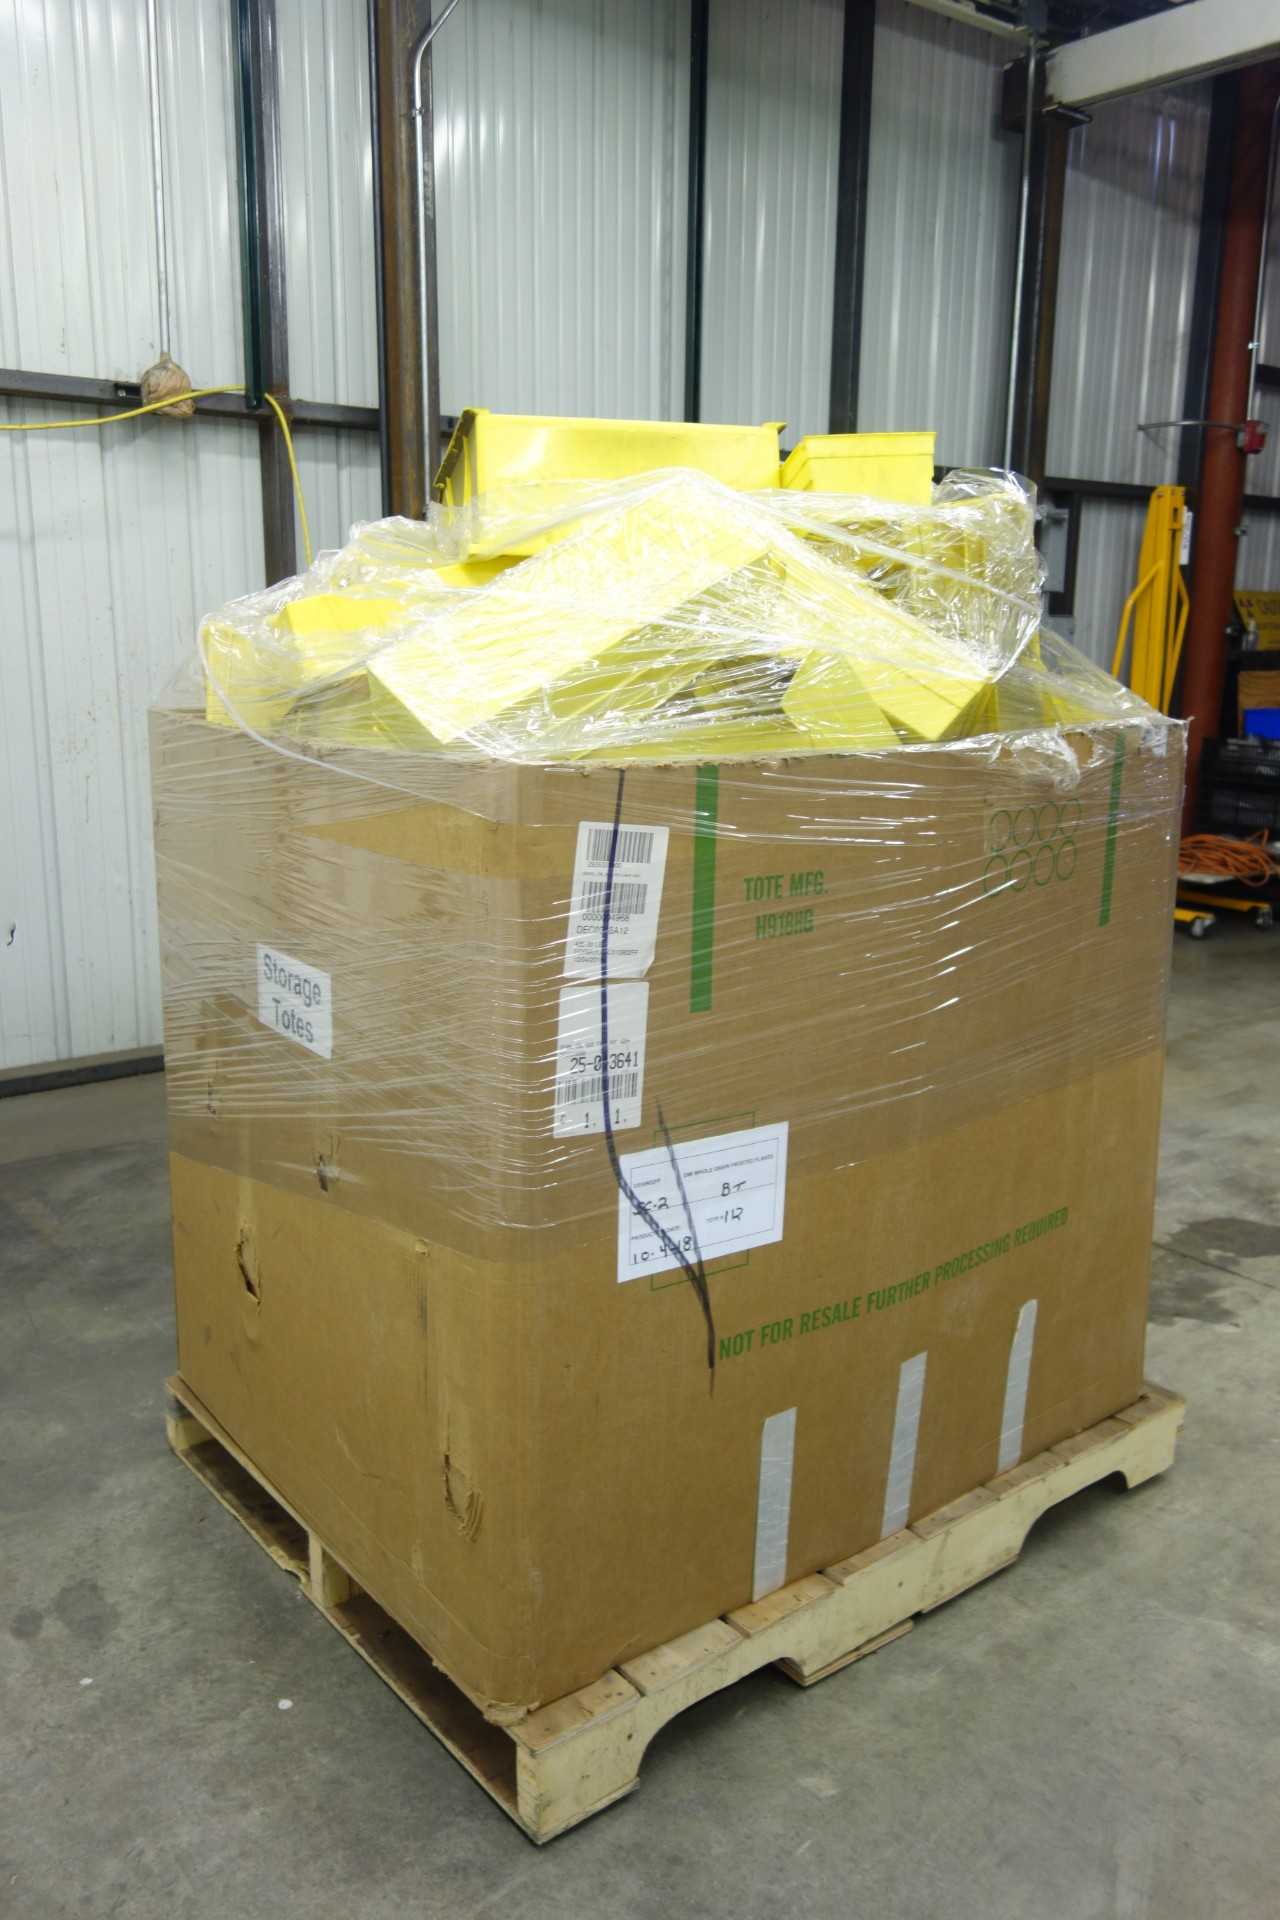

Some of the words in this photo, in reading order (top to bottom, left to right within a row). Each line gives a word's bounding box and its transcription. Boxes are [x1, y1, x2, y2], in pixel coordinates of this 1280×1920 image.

[744, 873, 784, 902] TOTE
[789, 869, 828, 896] MFG.
[263, 953, 321, 1008] Storage
[272, 996, 314, 1043] Totes
[570, 1051, 638, 1075] 25-03641
[719, 1329, 755, 1361] NOT
[760, 1318, 794, 1347] FOR
[800, 1296, 862, 1335] RESALE
[866, 1271, 931, 1313] FURTHER
[934, 1233, 1010, 1287] PROCESSING
[1014, 1206, 1069, 1247] REQUIRED
